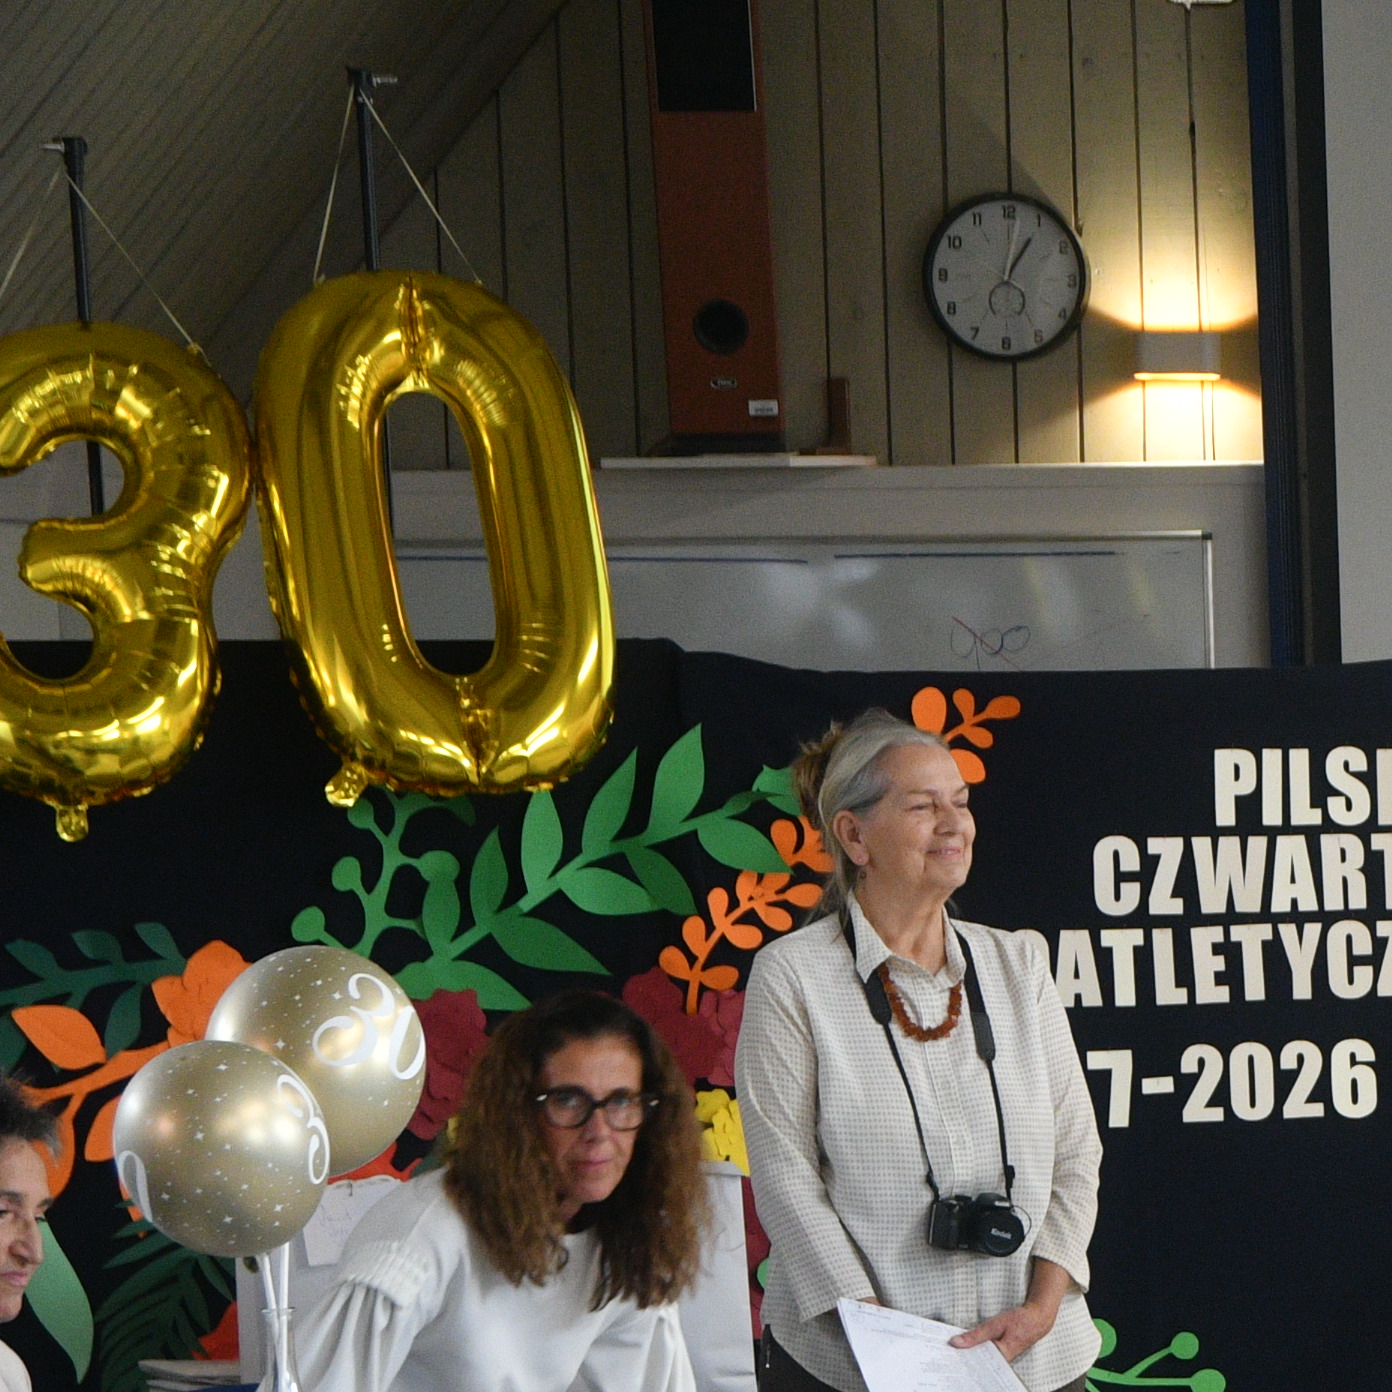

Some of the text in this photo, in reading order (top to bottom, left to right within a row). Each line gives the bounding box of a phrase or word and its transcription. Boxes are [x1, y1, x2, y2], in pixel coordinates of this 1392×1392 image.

[973, 212, 982, 226] 11
[1002, 205, 1016, 220] 12
[947, 235, 962, 249] 10
[1087, 1038, 1378, 1128] 7-2026
